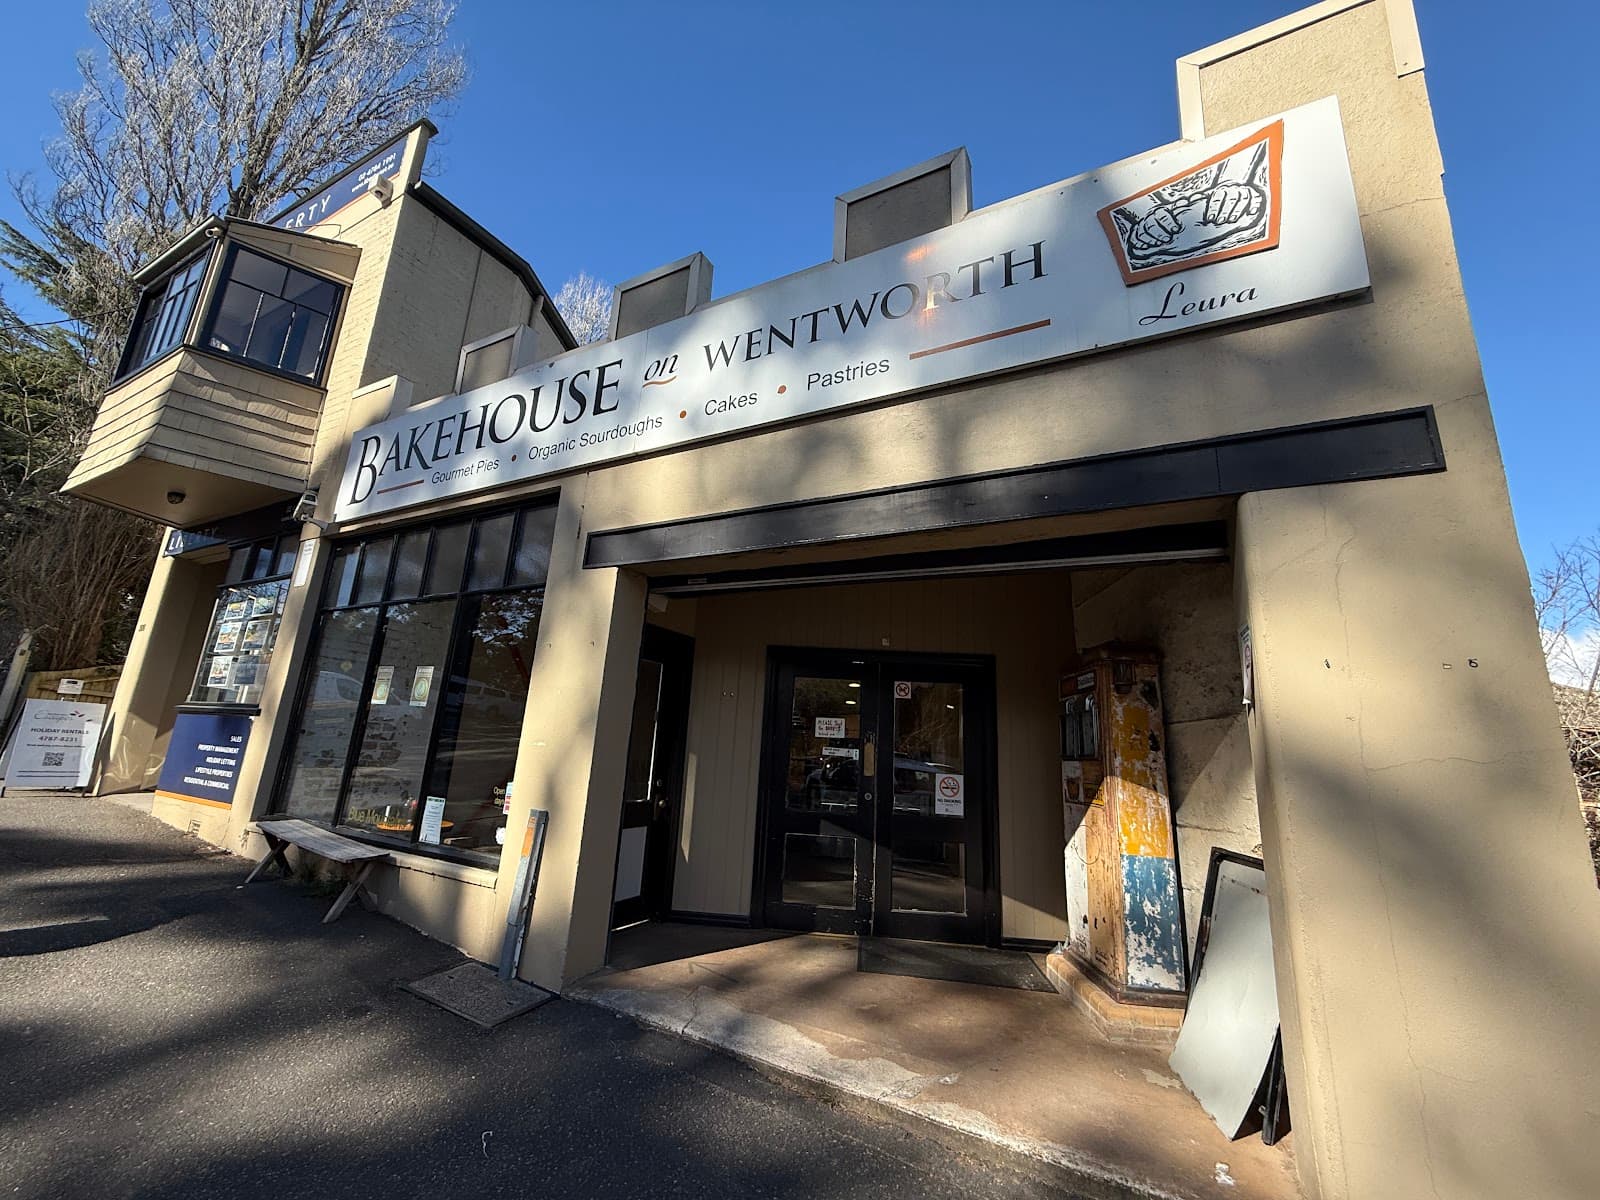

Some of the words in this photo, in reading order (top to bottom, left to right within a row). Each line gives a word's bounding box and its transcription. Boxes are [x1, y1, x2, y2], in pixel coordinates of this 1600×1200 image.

[1138, 281, 1258, 326] Leura
[346, 359, 624, 506] BAKEHOUSE
[643, 353, 679, 381] on
[703, 239, 1048, 372] WENTWORTH
[431, 463, 474, 485] Gourmet
[476, 457, 500, 475] Pies
[528, 437, 576, 462] Organic
[579, 413, 663, 448] Sourdoughs
[704, 390, 758, 416] Cakes
[806, 358, 890, 391] Pastries
[198, 744, 215, 752] PROPERTY
